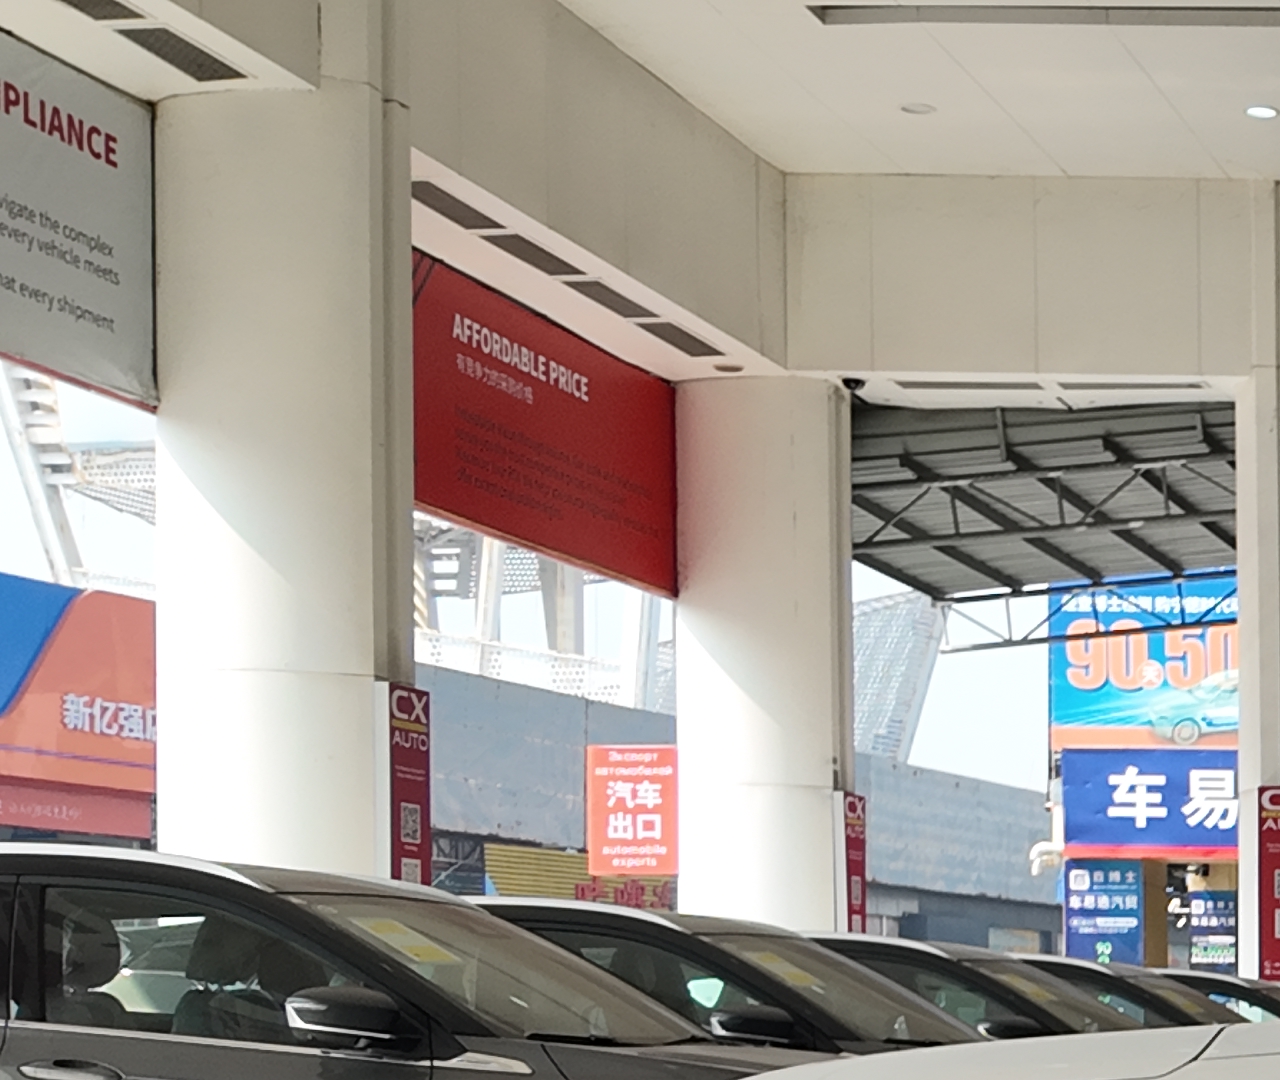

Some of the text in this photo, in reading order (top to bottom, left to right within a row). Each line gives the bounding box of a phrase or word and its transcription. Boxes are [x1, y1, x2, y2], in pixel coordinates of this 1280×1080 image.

[0, 80, 118, 169] PLIANCE
[0, 192, 114, 258] igate the complex
[36, 239, 81, 269] vehicle
[83, 258, 121, 286] meets
[19, 282, 55, 312] every
[57, 295, 115, 333] shipment
[452, 312, 590, 402] AFFORDABLE PRICE
[391, 688, 428, 724] CX
[392, 730, 429, 751] AUTO
[606, 780, 662, 808] 汽车
[846, 796, 864, 819] CX
[607, 811, 662, 840] 出口
